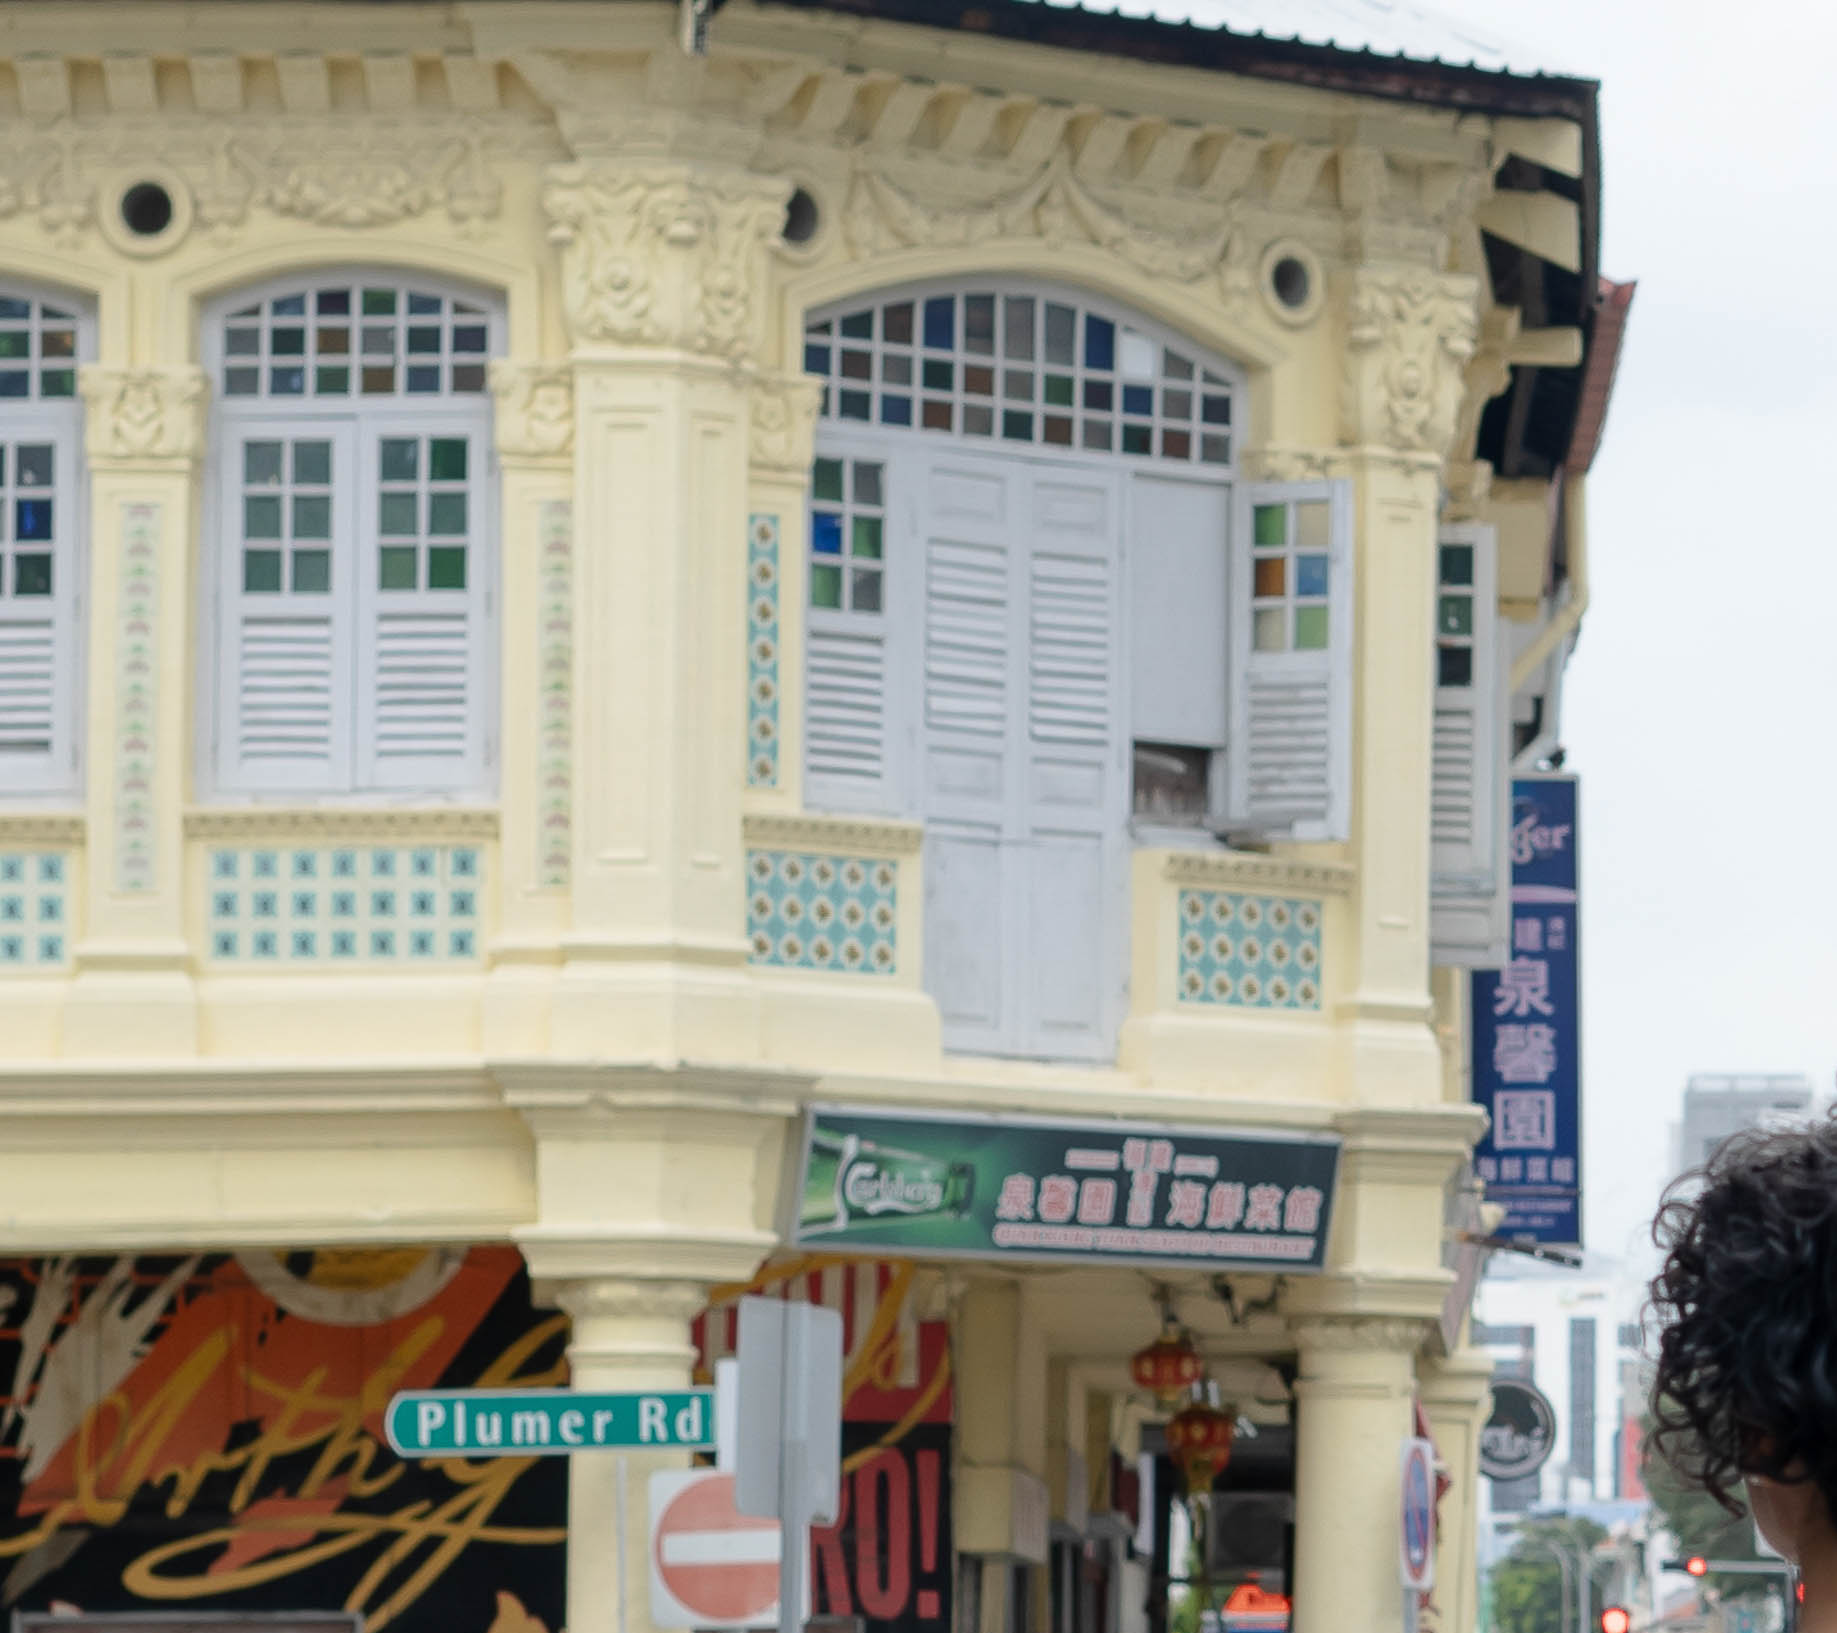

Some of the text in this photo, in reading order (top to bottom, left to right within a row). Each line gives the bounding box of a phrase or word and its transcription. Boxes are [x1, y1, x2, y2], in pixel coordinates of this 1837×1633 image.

[1512, 812, 1570, 866] ger
[417, 1396, 702, 1447] Plumer Rd
[811, 1446, 941, 1621] RO!
